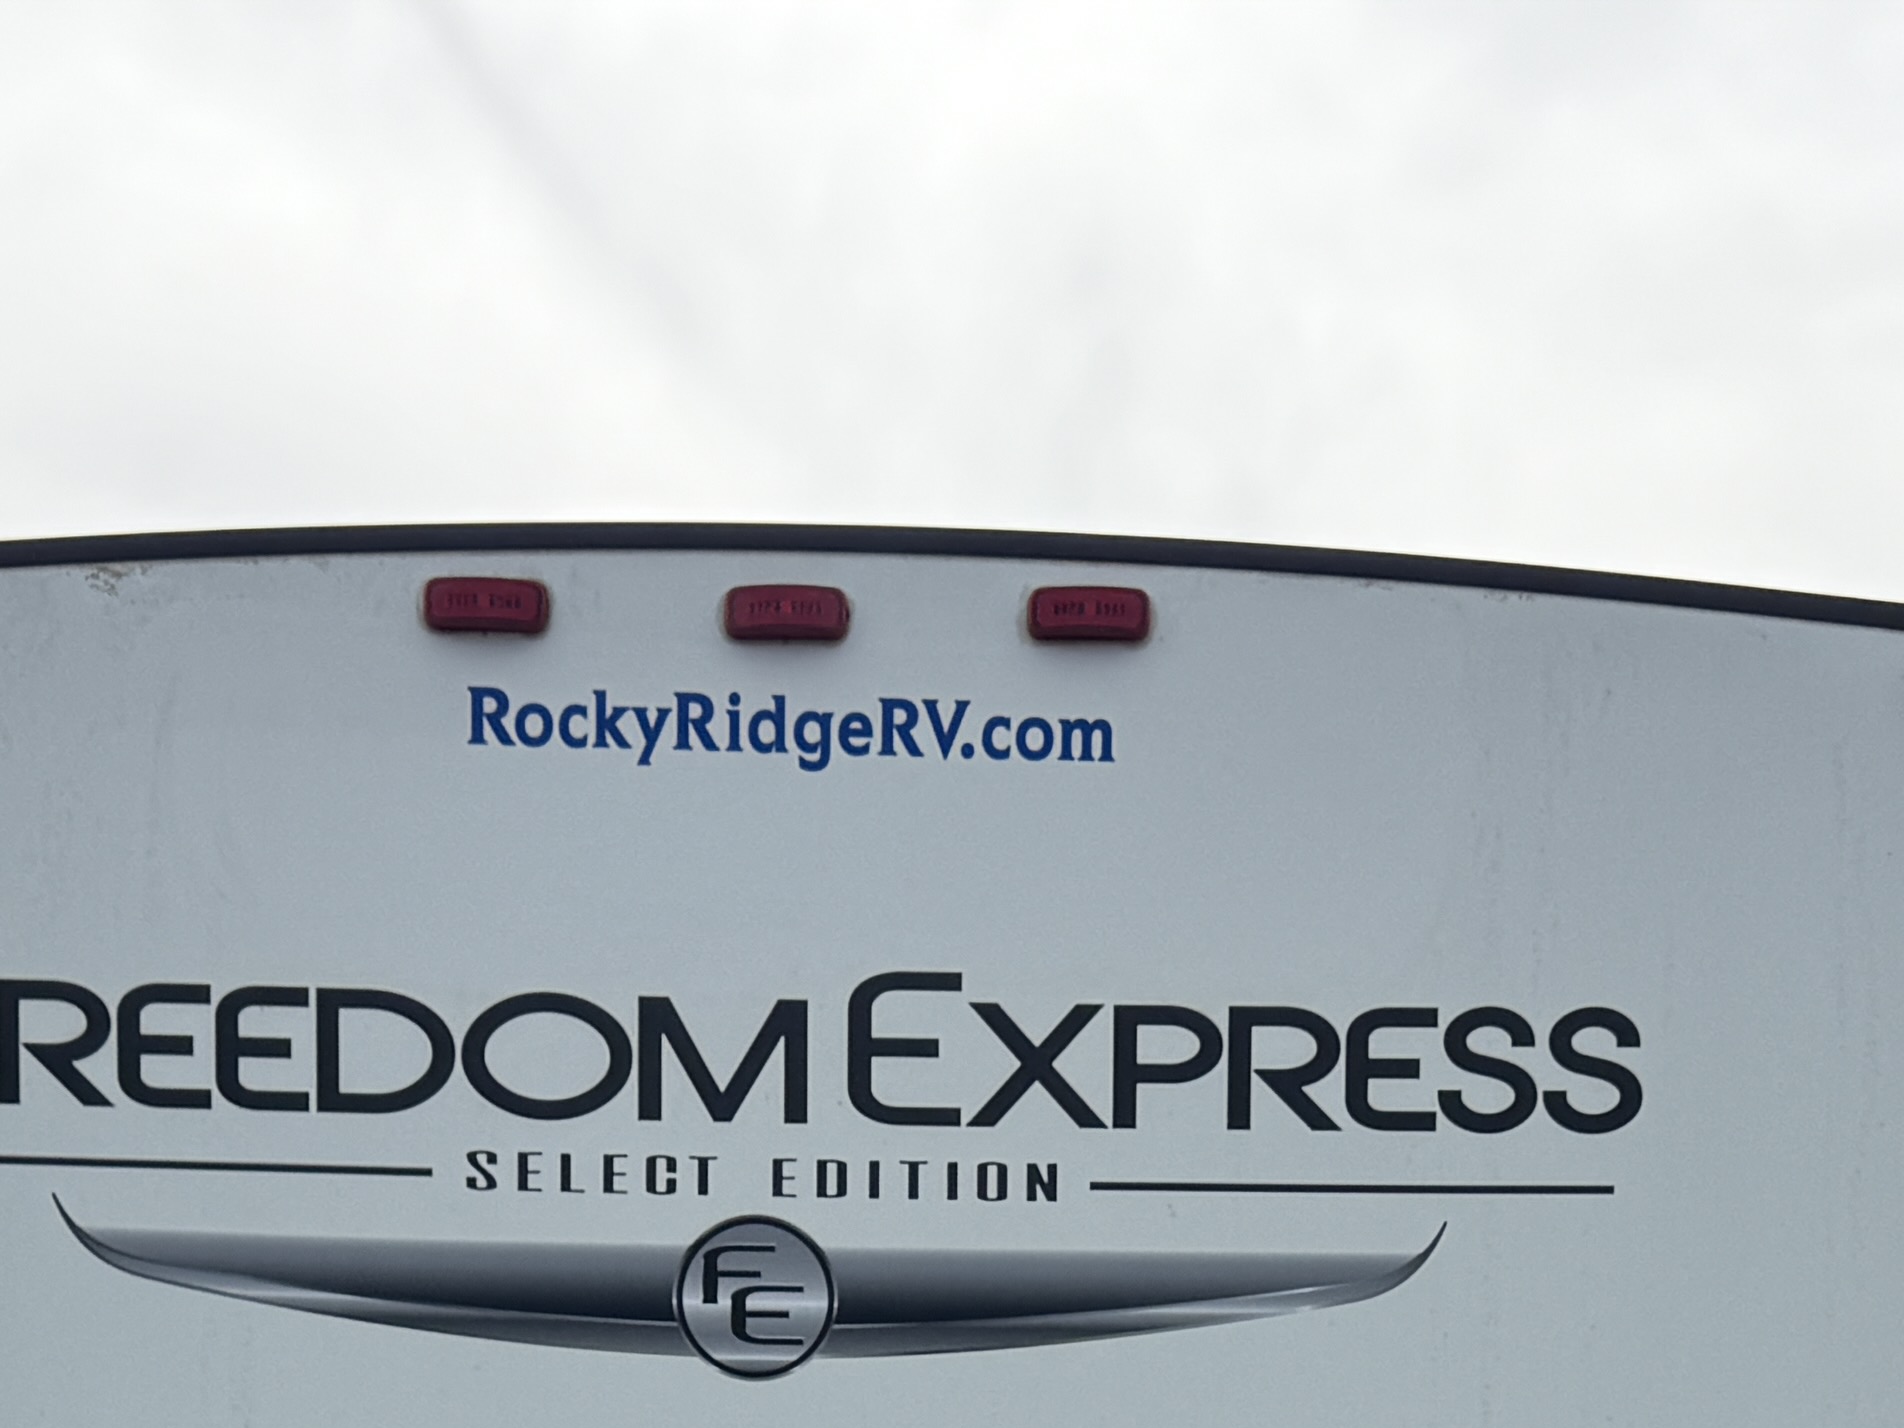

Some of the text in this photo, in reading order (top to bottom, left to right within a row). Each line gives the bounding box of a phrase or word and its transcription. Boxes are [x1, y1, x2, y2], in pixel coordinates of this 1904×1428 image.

[467, 685, 1115, 772] RockyRidgeRV.com
[847, 971, 1643, 1135] EXPRESS
[465, 1150, 1058, 1203] SELECT EDITION
